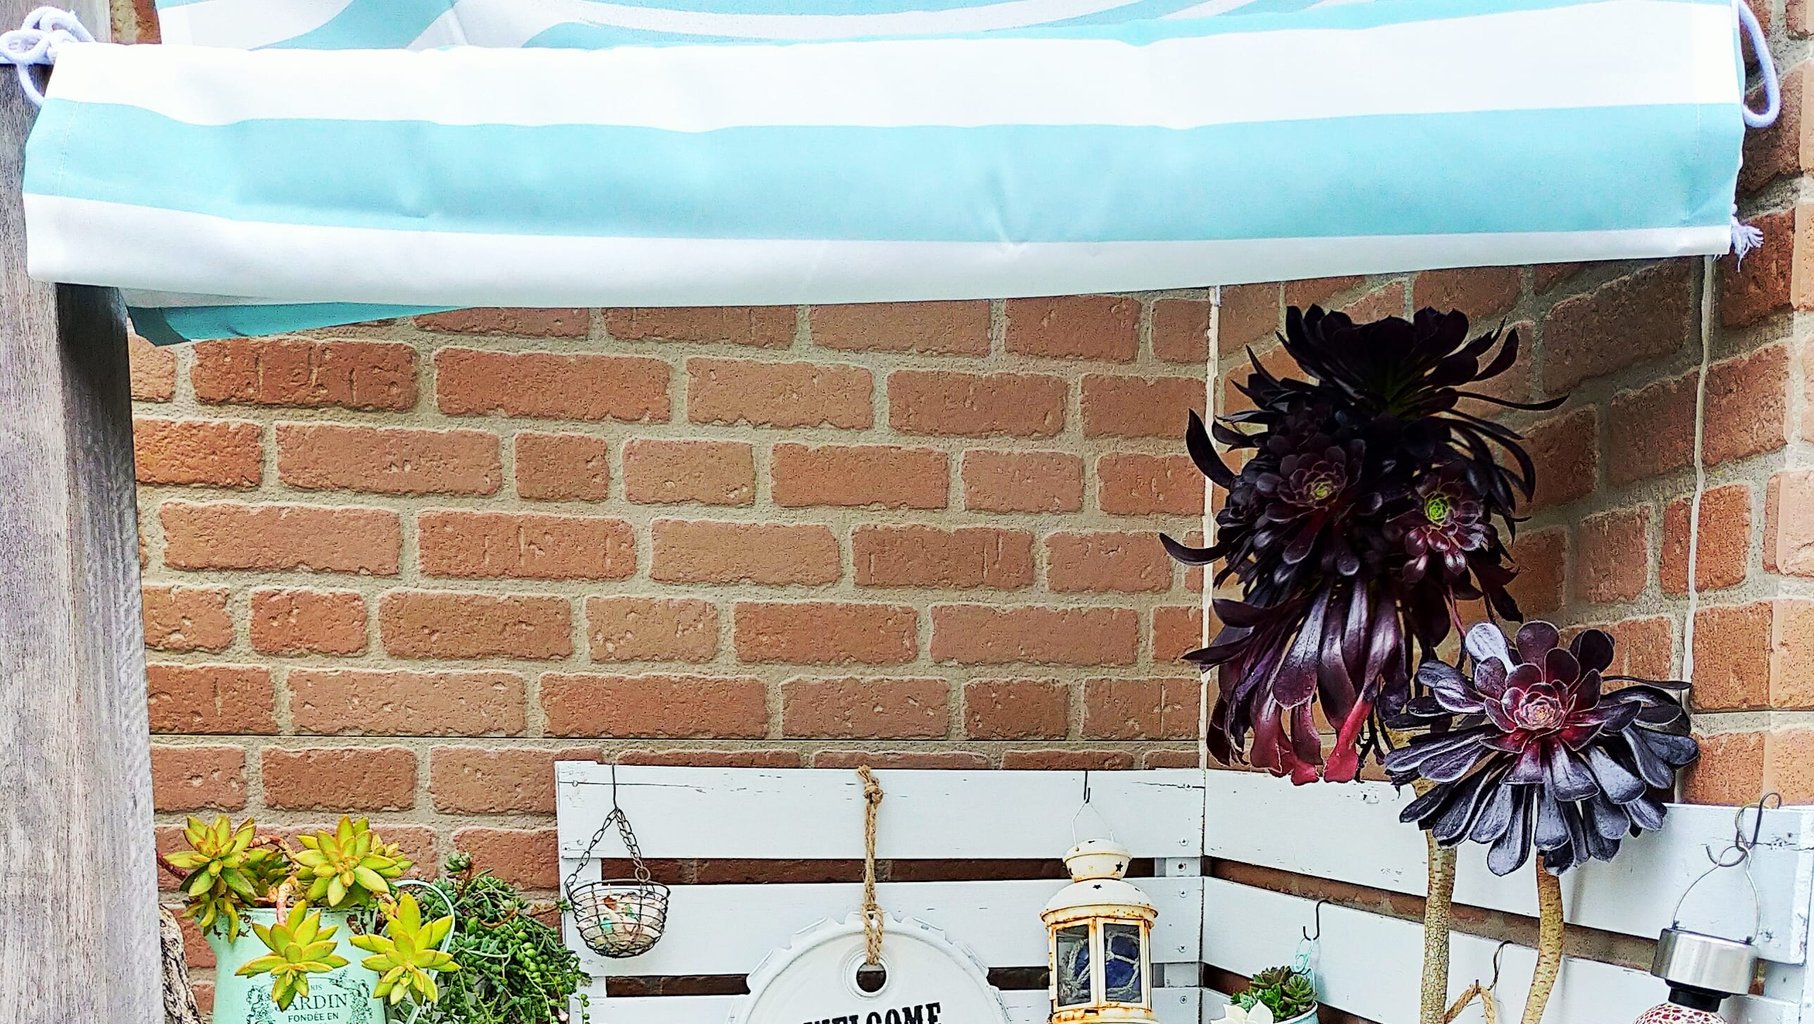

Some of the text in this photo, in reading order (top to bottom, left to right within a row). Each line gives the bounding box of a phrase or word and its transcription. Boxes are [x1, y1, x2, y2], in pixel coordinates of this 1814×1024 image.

[275, 993, 348, 1012] ARDIN
[288, 1012, 339, 1022] FONDÉE EN
